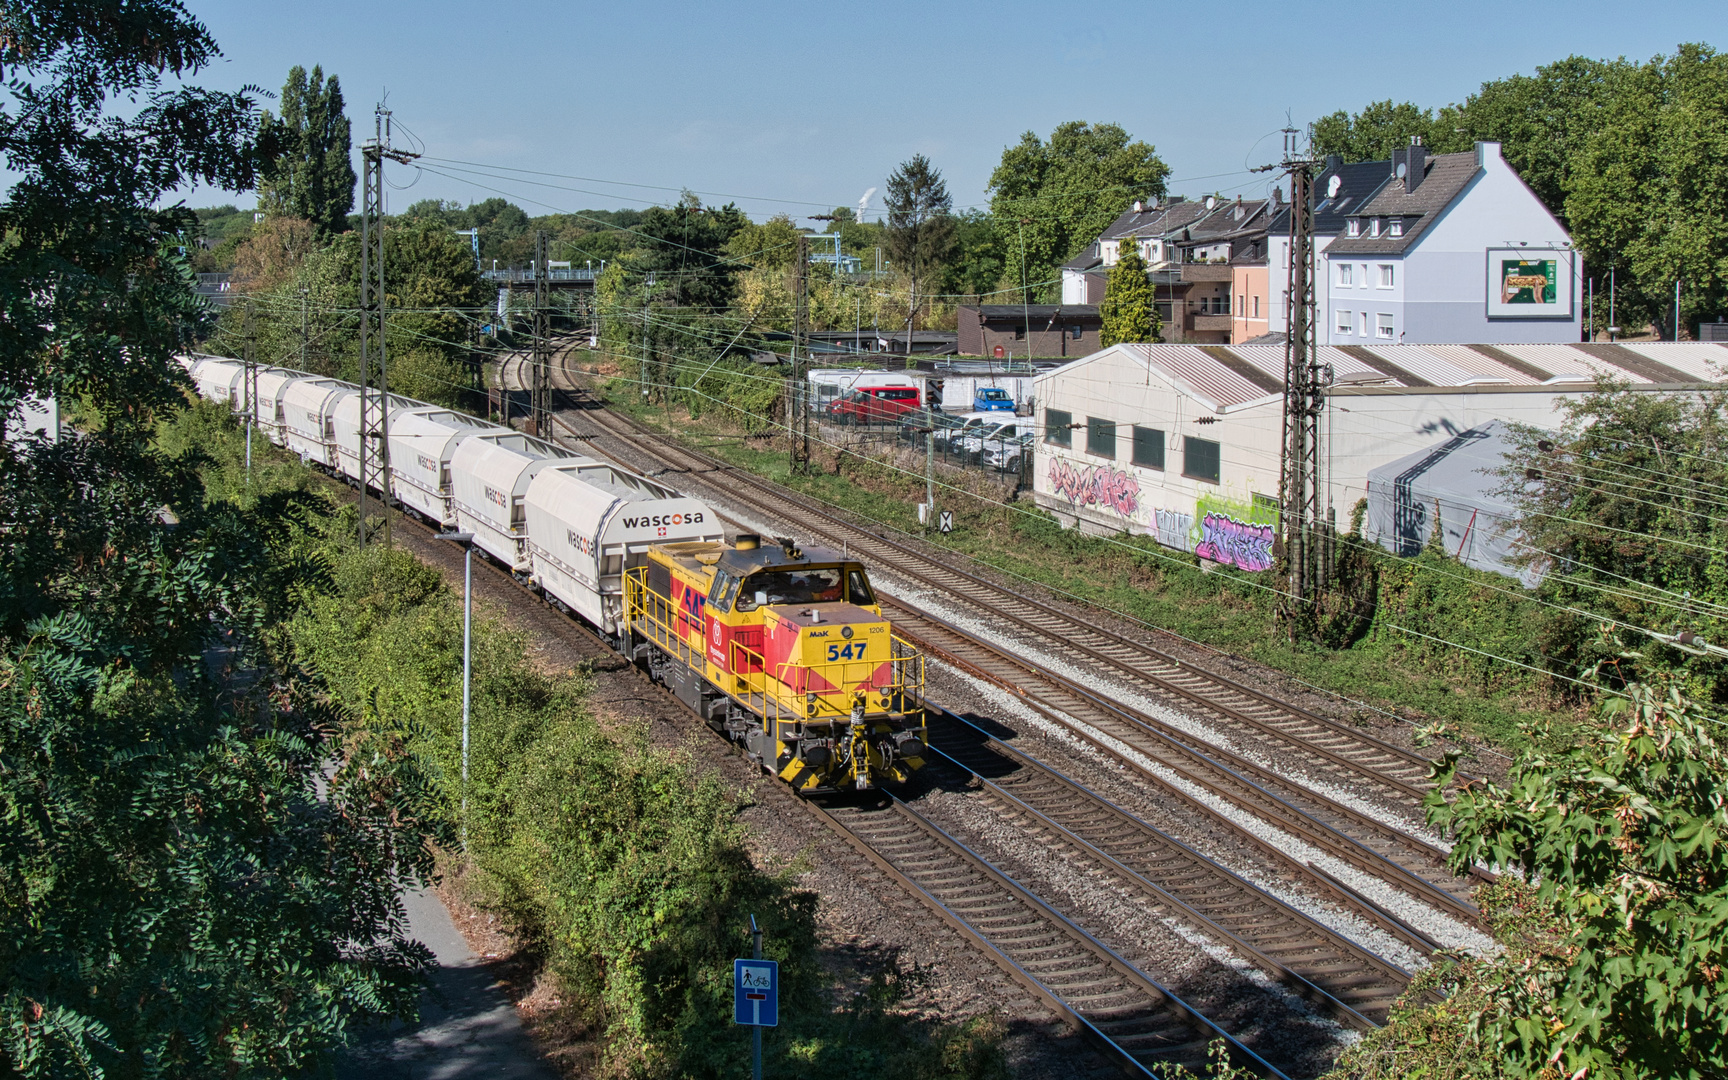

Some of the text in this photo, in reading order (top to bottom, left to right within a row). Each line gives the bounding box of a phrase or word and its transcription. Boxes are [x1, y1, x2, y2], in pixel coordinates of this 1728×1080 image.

[417, 453, 436, 472] wascosa
[484, 485, 506, 509] wascosa
[622, 512, 704, 529] wascosa
[566, 528, 595, 558] wascosa
[869, 626, 885, 634] 1206
[827, 642, 867, 662] 547
